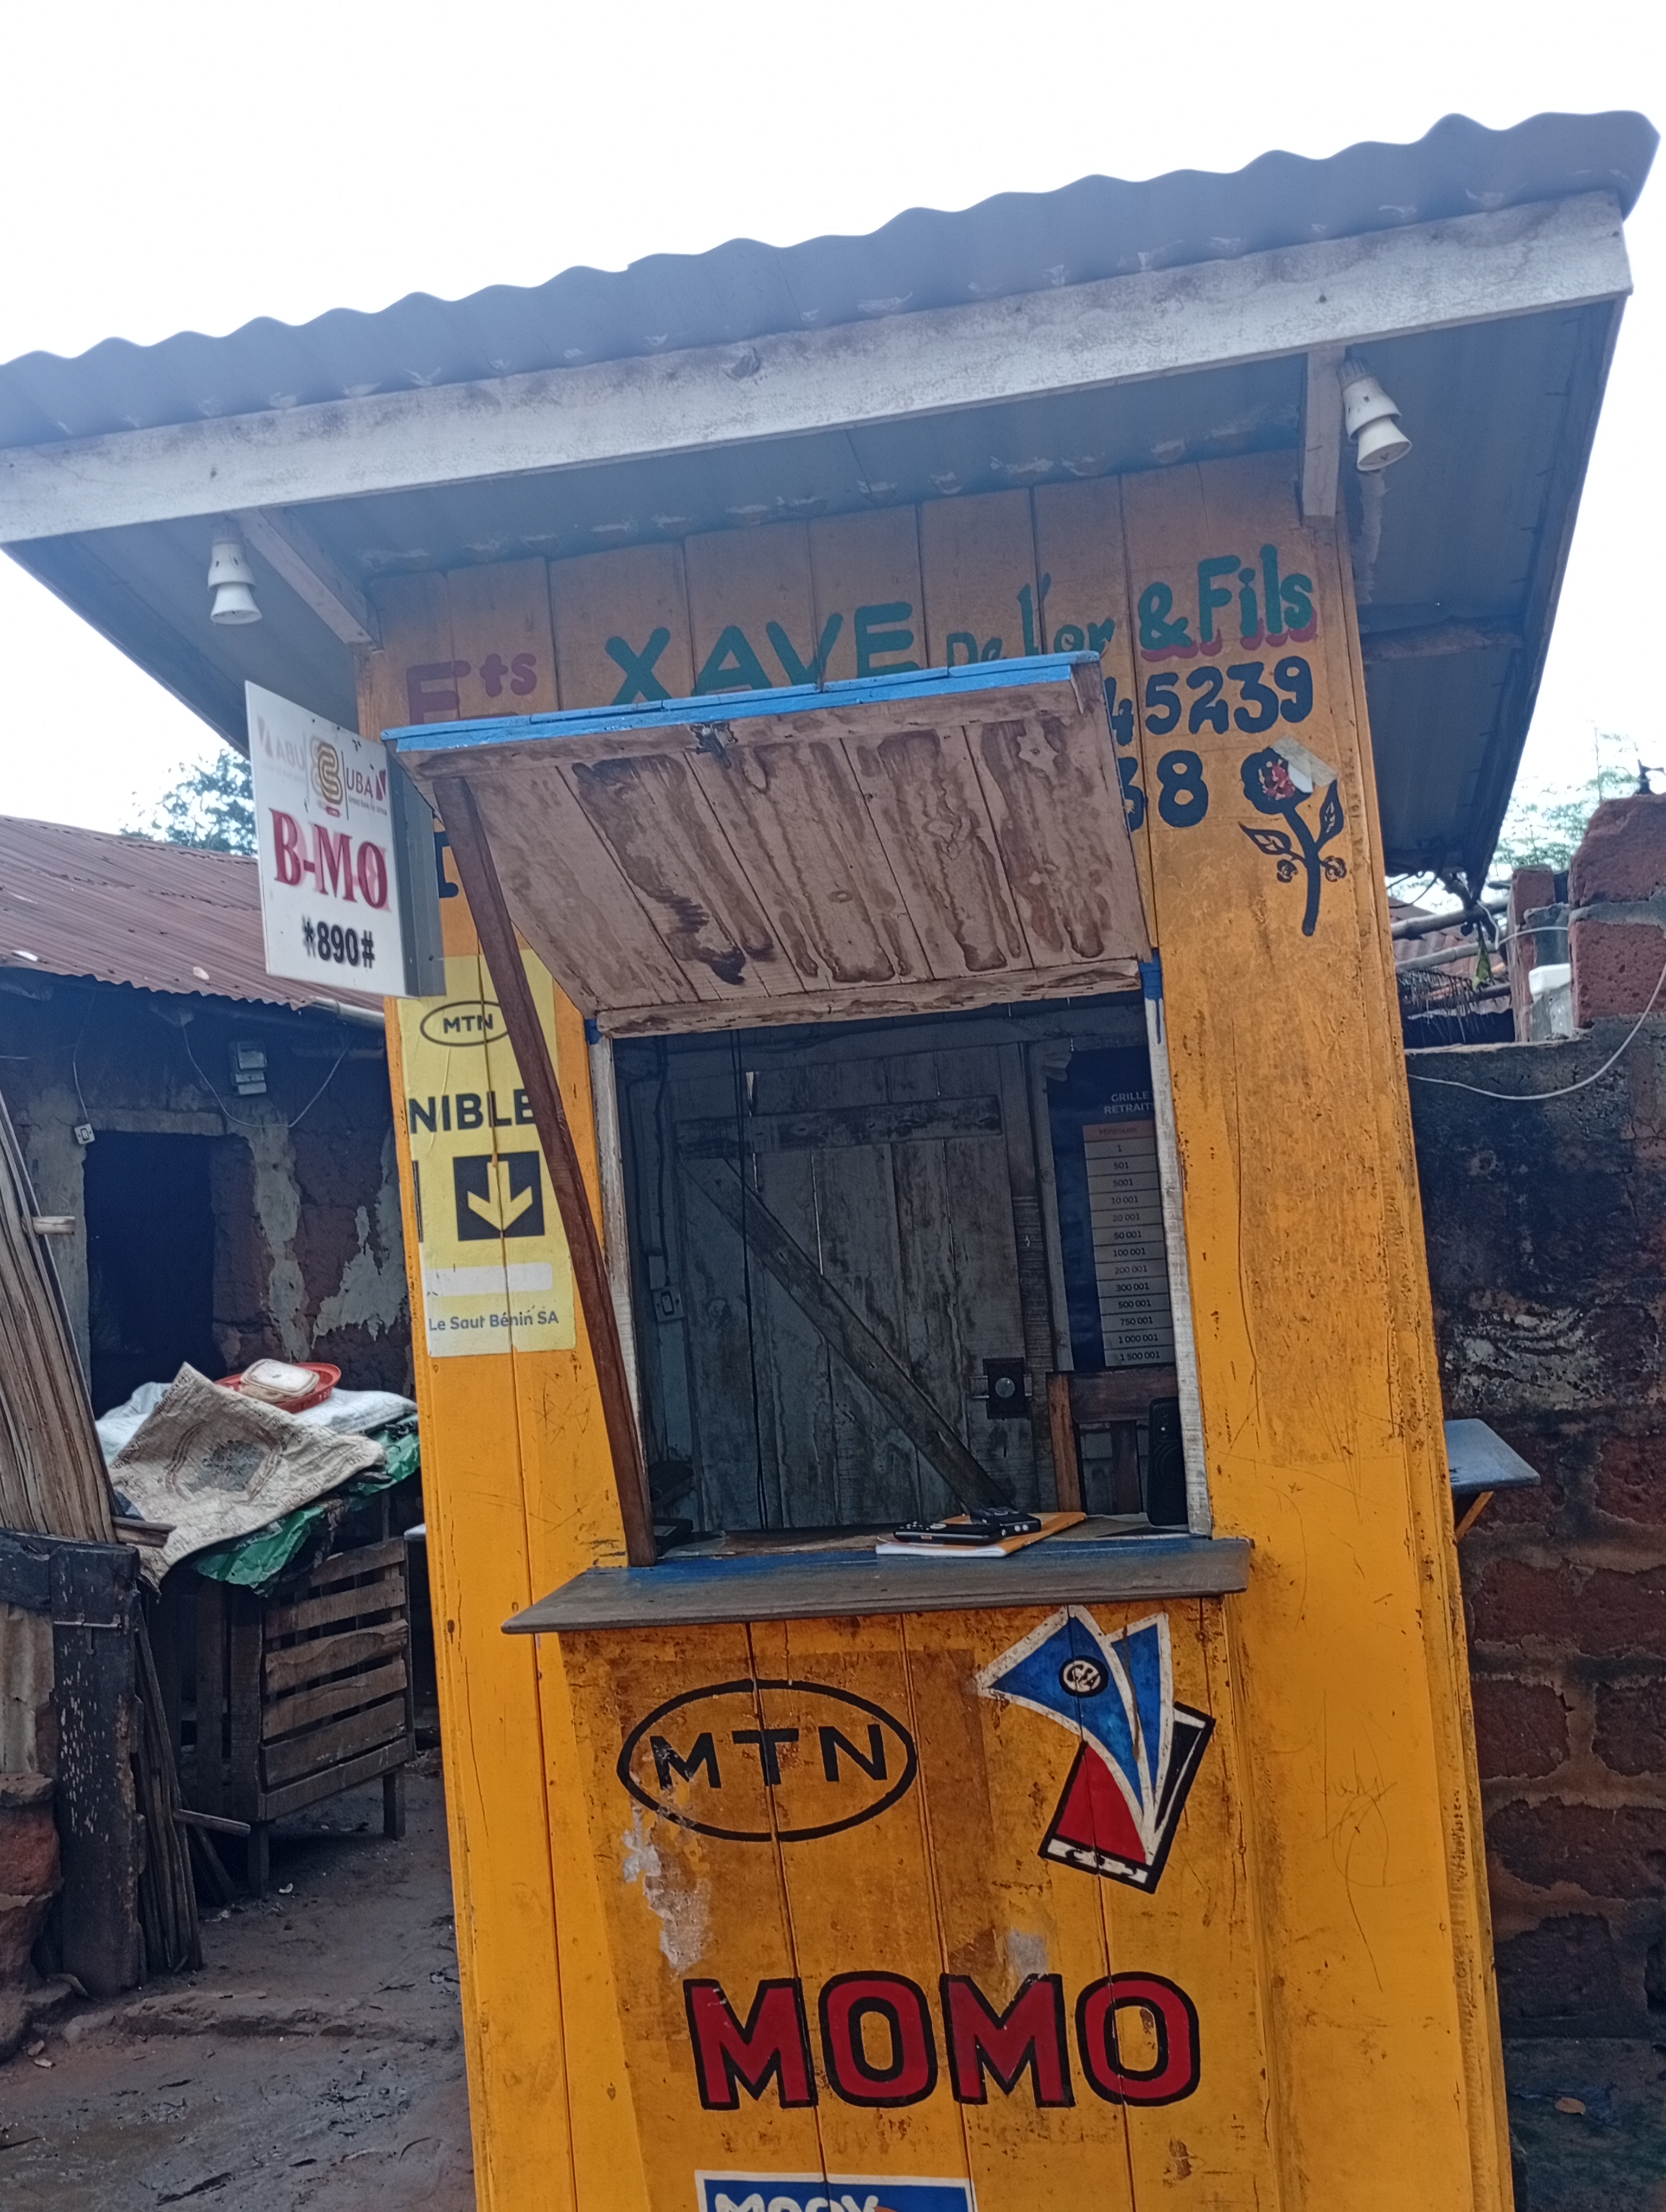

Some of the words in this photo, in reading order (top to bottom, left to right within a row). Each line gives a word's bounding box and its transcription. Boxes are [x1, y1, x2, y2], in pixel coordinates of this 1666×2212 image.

[605, 602, 920, 706] XAVE
[1138, 583, 1193, 650] &
[1197, 544, 1312, 642] Fils
[346, 767, 373, 799] UBA
[268, 808, 389, 909] B-MO
[443, 1013, 494, 1034] MTN
[1111, 1091, 1149, 1102] GRILLE
[1114, 1162, 1129, 1170] 501
[1113, 1179, 1133, 1187] 5001
[429, 1319, 445, 1331] Le
[450, 1315, 485, 1330] Saut
[490, 1311, 533, 1327] Bénin
[537, 1310, 559, 1324] SA
[651, 1724, 888, 1790] MTN
[682, 1971, 1200, 2110] MOMO
